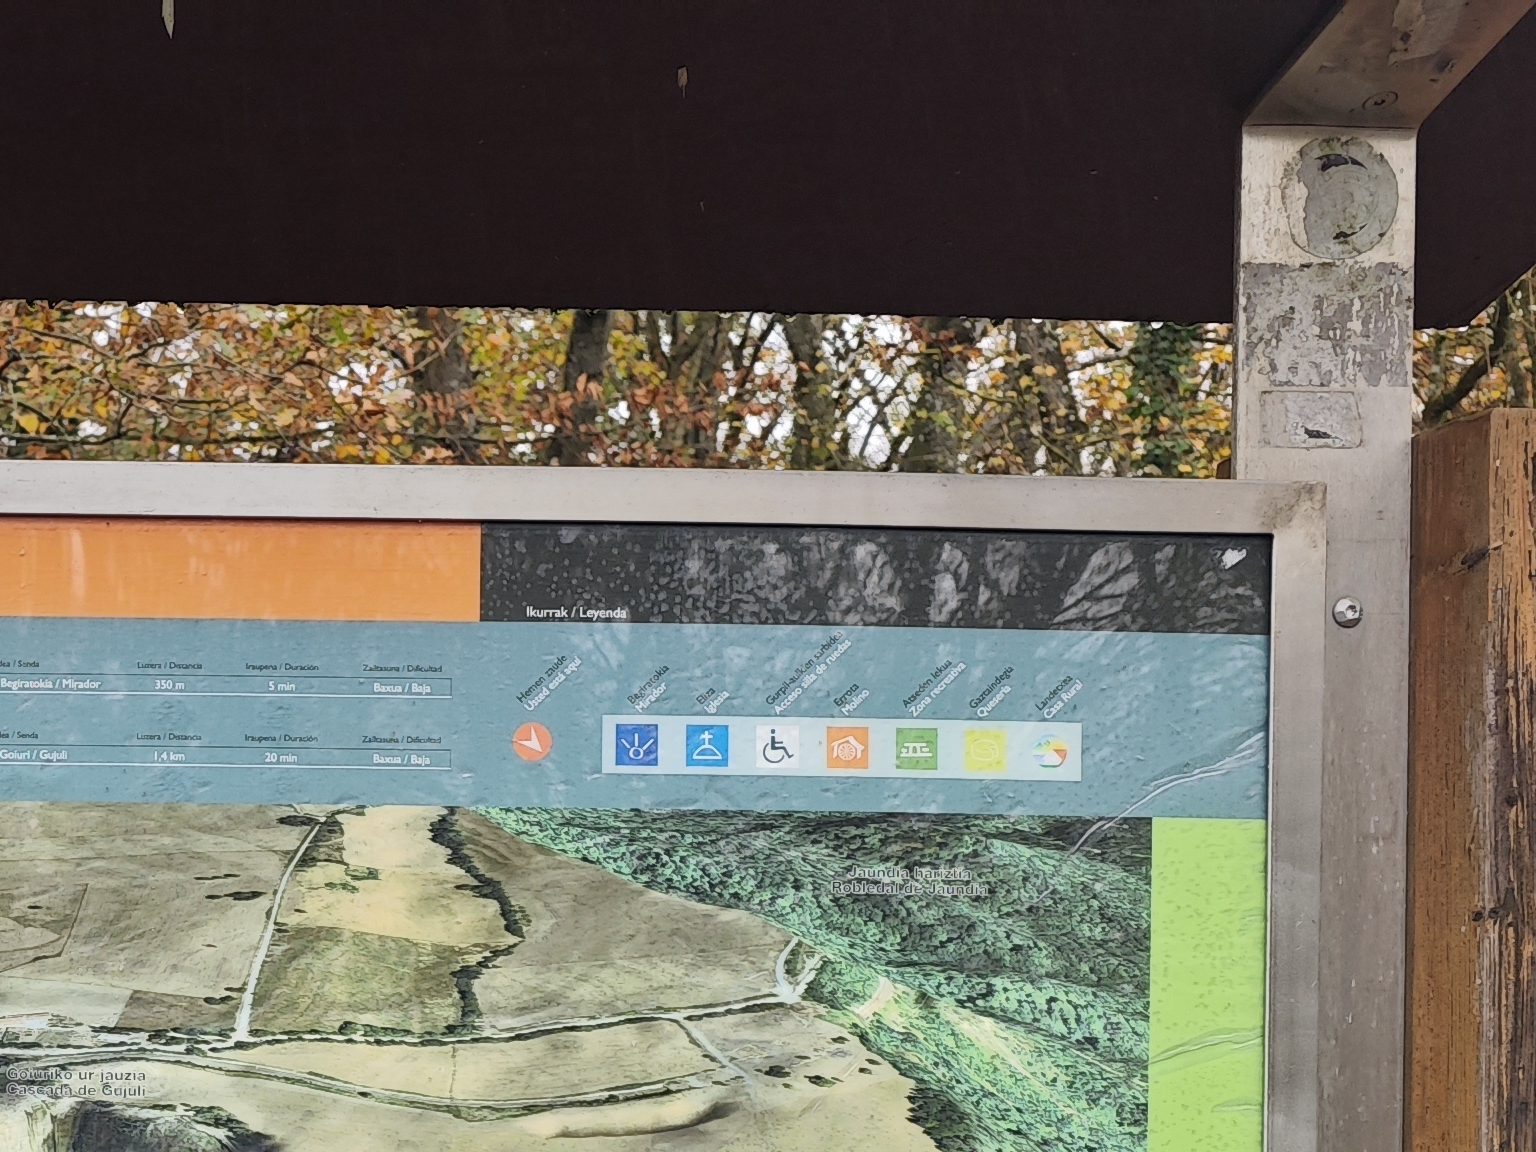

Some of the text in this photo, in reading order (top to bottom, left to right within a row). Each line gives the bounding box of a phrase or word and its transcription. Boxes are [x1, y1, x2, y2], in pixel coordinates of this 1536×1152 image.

[526, 606, 568, 617] Ikurrak
[579, 606, 627, 621] Leyenda
[774, 687, 802, 715] Acceso
[815, 663, 828, 675] de
[826, 639, 852, 665] ruedas
[932, 659, 953, 680] lekua
[0, 678, 53, 690] Begiratokia
[62, 679, 101, 690] Mirador
[154, 680, 185, 690] 350 m
[268, 681, 296, 691] 5 min
[374, 682, 402, 692] Baxua
[412, 683, 431, 695] Baja
[516, 675, 545, 703] Hemen
[524, 687, 550, 711] Usted
[635, 682, 667, 712] Mirador
[696, 687, 716, 705] Eliza
[704, 690, 730, 713] Iglesia
[833, 683, 859, 708] Errota
[841, 689, 869, 716] Molino
[1043, 679, 1084, 719] Casa Rural
[908, 692, 933, 717] Zona
[0, 749, 30, 759] Goiuri
[39, 750, 67, 761] Gujuli
[154, 751, 185, 762] 1,4 km
[265, 753, 297, 763] 20 min
[373, 753, 401, 763] Baxua
[411, 754, 430, 766] Baja
[848, 865, 909, 879] Jaundia
[832, 881, 989, 895] Robledal de Jaundia
[6, 1067, 73, 1081] Goiuriko
[6, 1083, 146, 1098] Cascada de Gujuli
